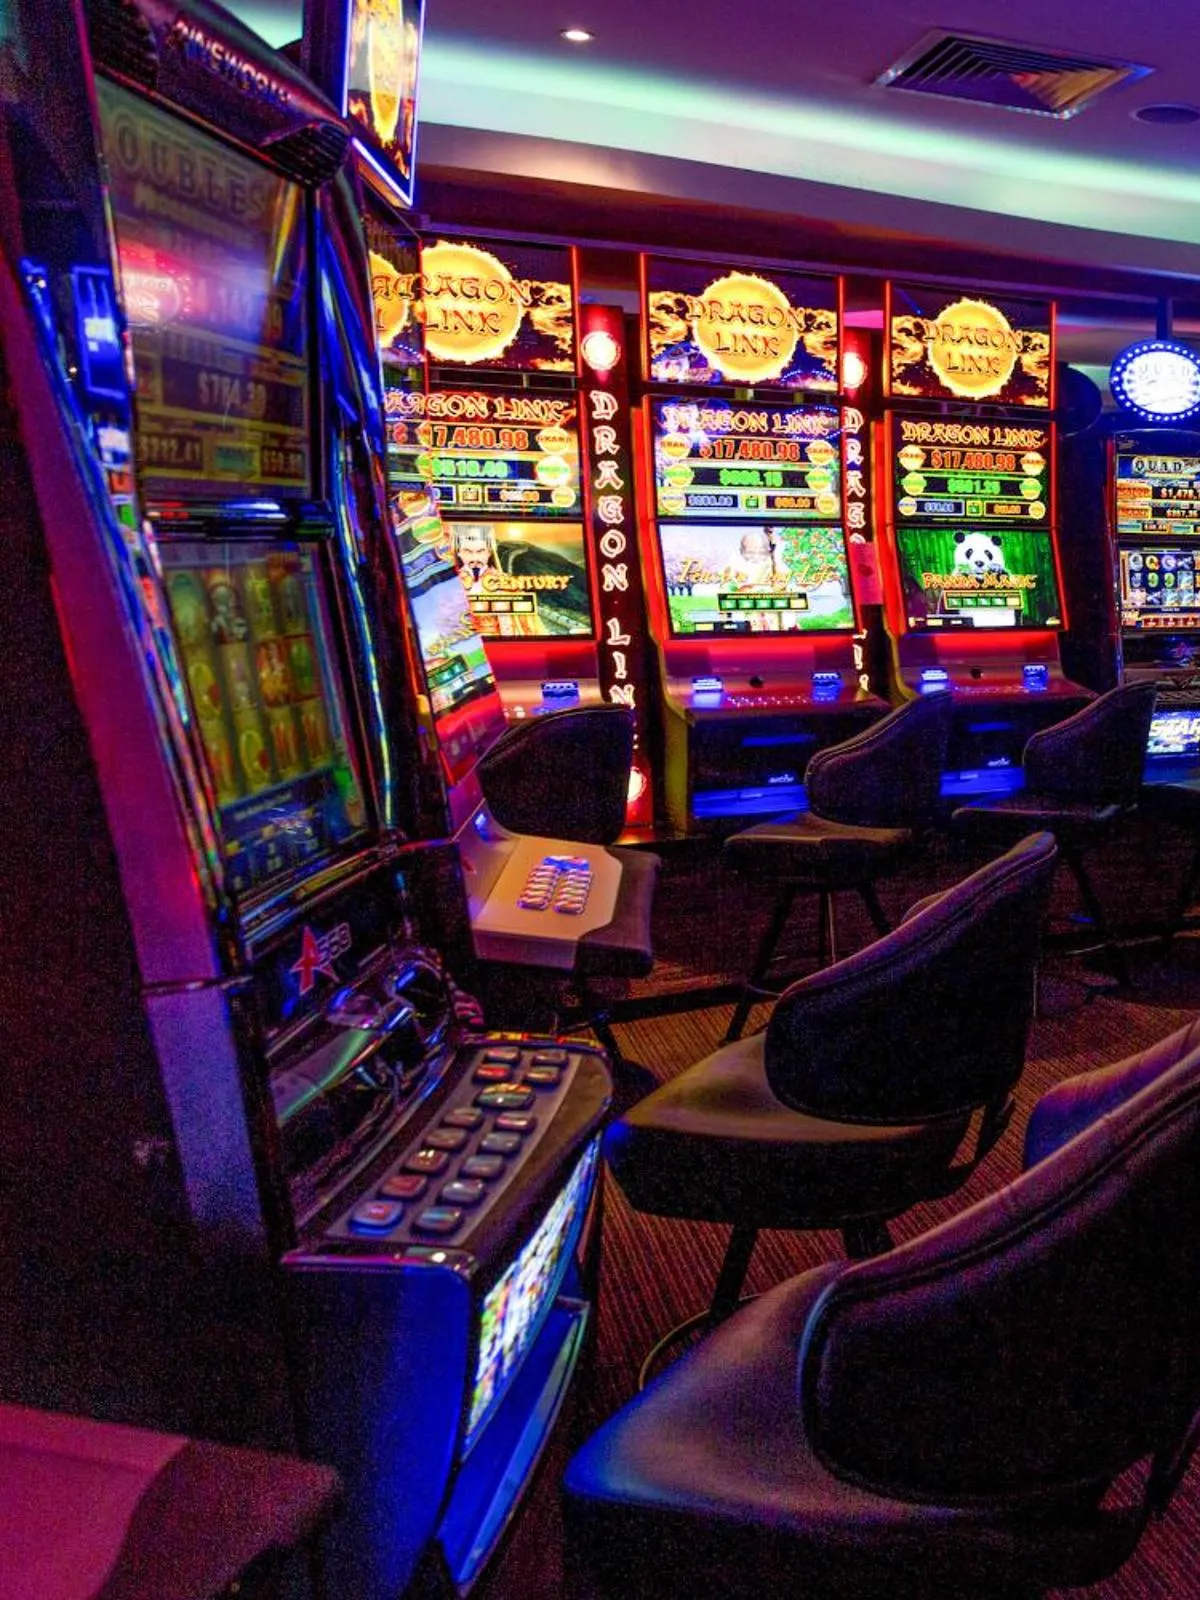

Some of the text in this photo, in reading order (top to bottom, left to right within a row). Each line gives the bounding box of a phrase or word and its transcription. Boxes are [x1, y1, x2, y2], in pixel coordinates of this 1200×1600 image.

[688, 297, 805, 330] DRAGON
[714, 332, 781, 357] LINK
[925, 323, 1023, 353] DRAGON
[946, 352, 1000, 376] LINK
[432, 425, 529, 450] 7,480.98
[900, 421, 1045, 449] DRAGON LINK
[482, 574, 570, 592] CENTURY
[606, 617, 639, 710] LIN
